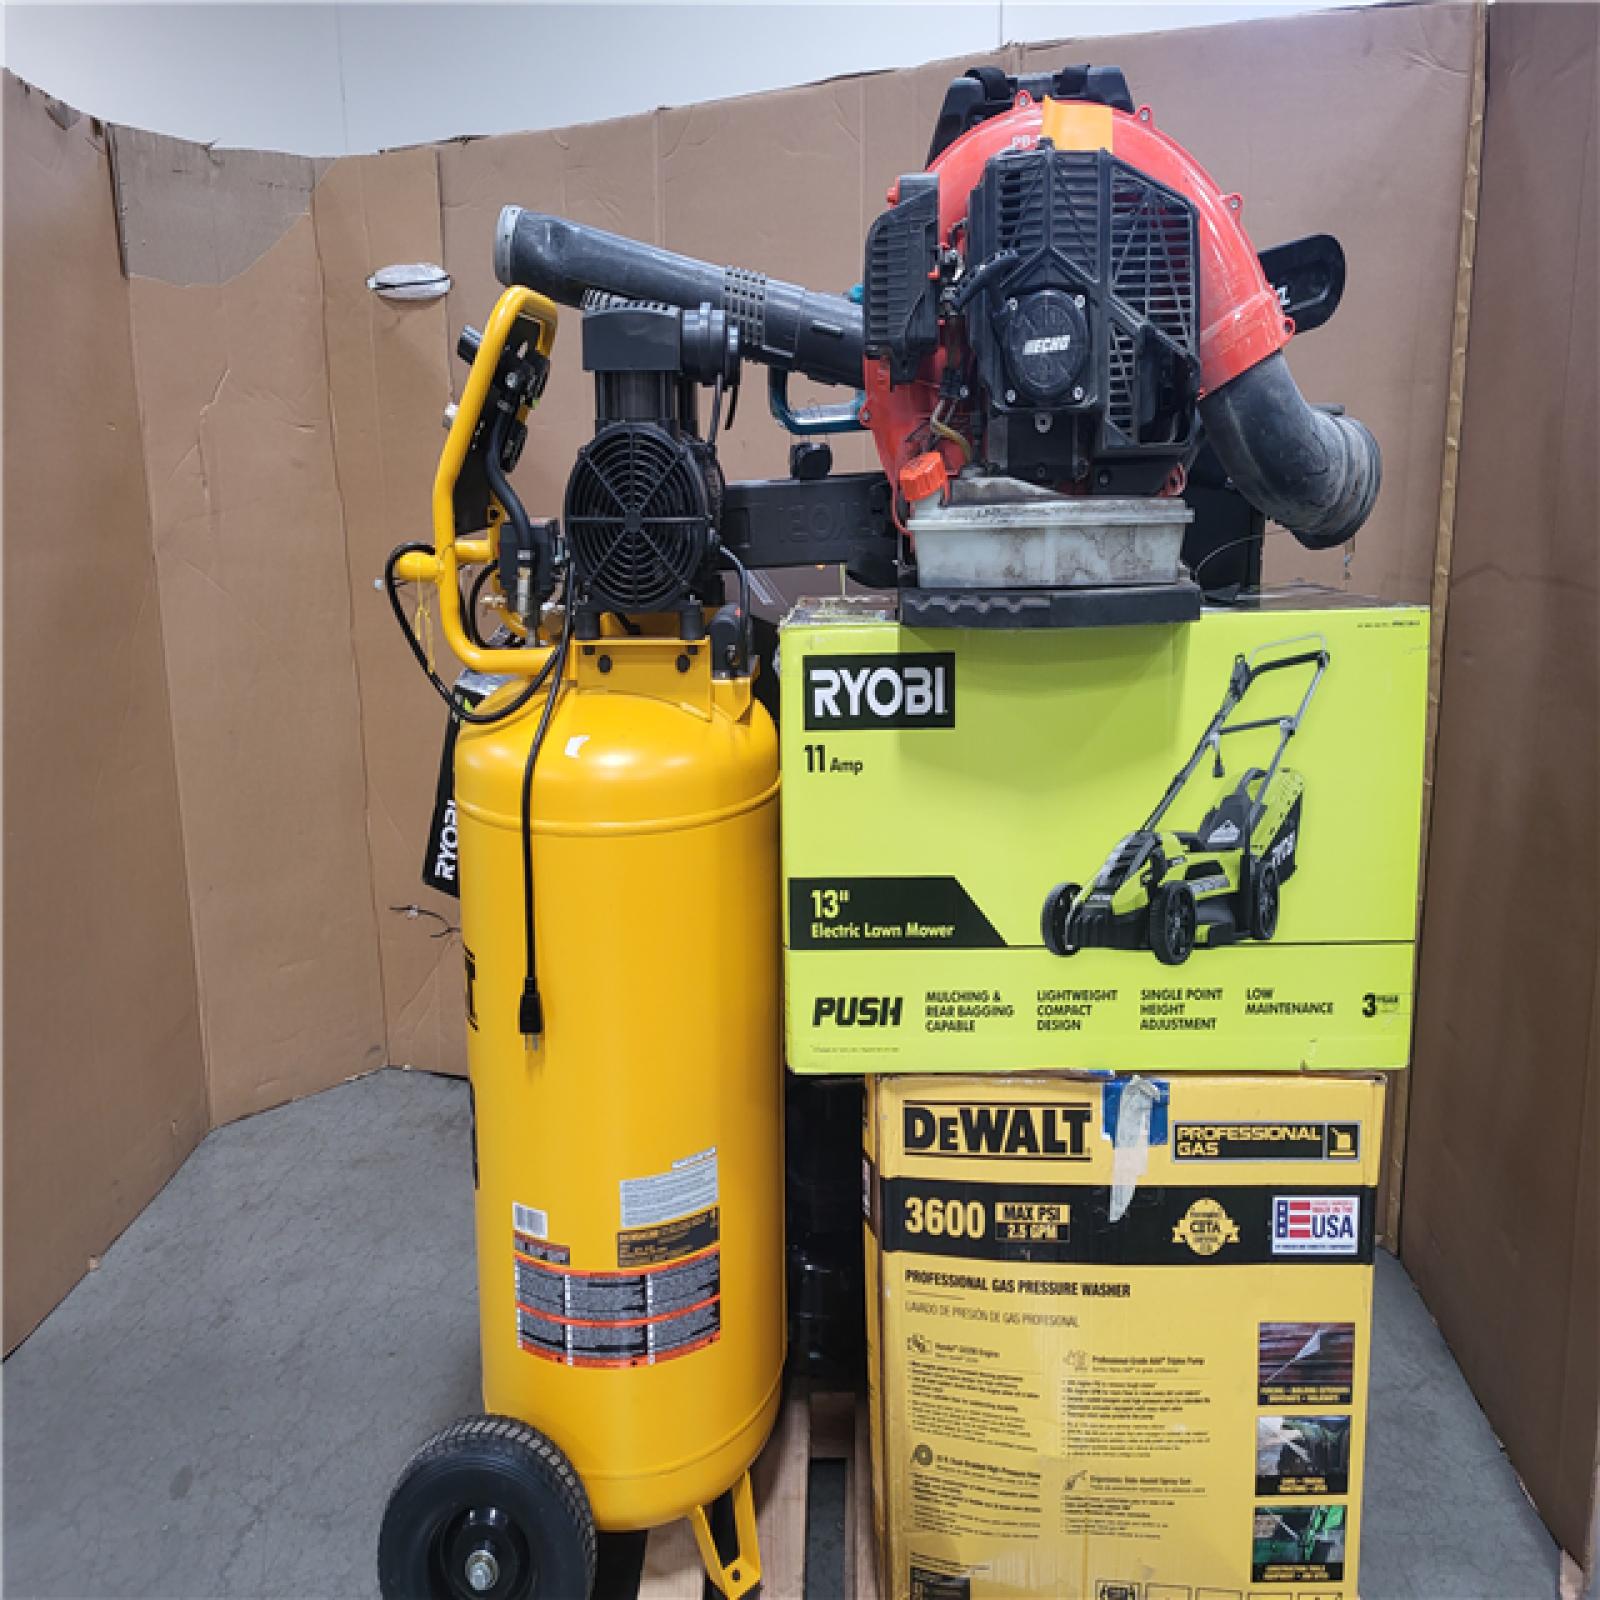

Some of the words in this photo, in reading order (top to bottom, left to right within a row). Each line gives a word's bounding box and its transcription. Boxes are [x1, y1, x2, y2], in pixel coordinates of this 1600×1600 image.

[810, 666, 946, 717] RYOBI
[805, 744, 825, 773] 11
[830, 757, 863, 775] Amp
[811, 889, 850, 919] 13"
[811, 922, 860, 939] Electric
[864, 922, 901, 939] Lawn
[905, 922, 955, 939] Mower
[925, 989, 989, 1003] MULCHING
[992, 990, 1001, 1002] &
[1037, 989, 1118, 1002] LIGHTWEIGHT
[1140, 988, 1183, 1001] SINGLE
[1186, 988, 1223, 1001] POINT
[1246, 987, 1274, 1000] LOW
[812, 996, 903, 1028] PUSH
[925, 1004, 955, 1017] REAR
[957, 1004, 1014, 1018] BAGGING
[1037, 1004, 1092, 1017] COMPACT
[1140, 1004, 1185, 1016] HEIGHT
[1245, 1002, 1334, 1015] MAINTENANCE
[1362, 992, 1377, 1018] 3
[925, 1019, 975, 1032] CAPABLE
[1037, 1019, 1082, 1031] DESIGN
[1140, 1017, 1217, 1030] ADJUSTMENT
[1177, 1126, 1321, 1141] PROFESSIONAL
[1177, 1141, 1220, 1156] GAS
[904, 1197, 985, 1239] 3600
[1005, 1204, 1032, 1221] MAX
[1039, 1204, 1061, 1221] PSI
[1312, 1214, 1354, 1239] USA
[905, 1268, 988, 1291] PROFESSIONAL
[992, 1279, 1015, 1293] GAS
[1018, 1280, 1078, 1296] PRESSURE
[1082, 1282, 1131, 1298] WASHER
[939, 1304, 950, 1316] DE
[990, 1310, 1000, 1323] DE
[1003, 1311, 1020, 1326] GAS
[1022, 1313, 1080, 1328] PROFESIONAL
